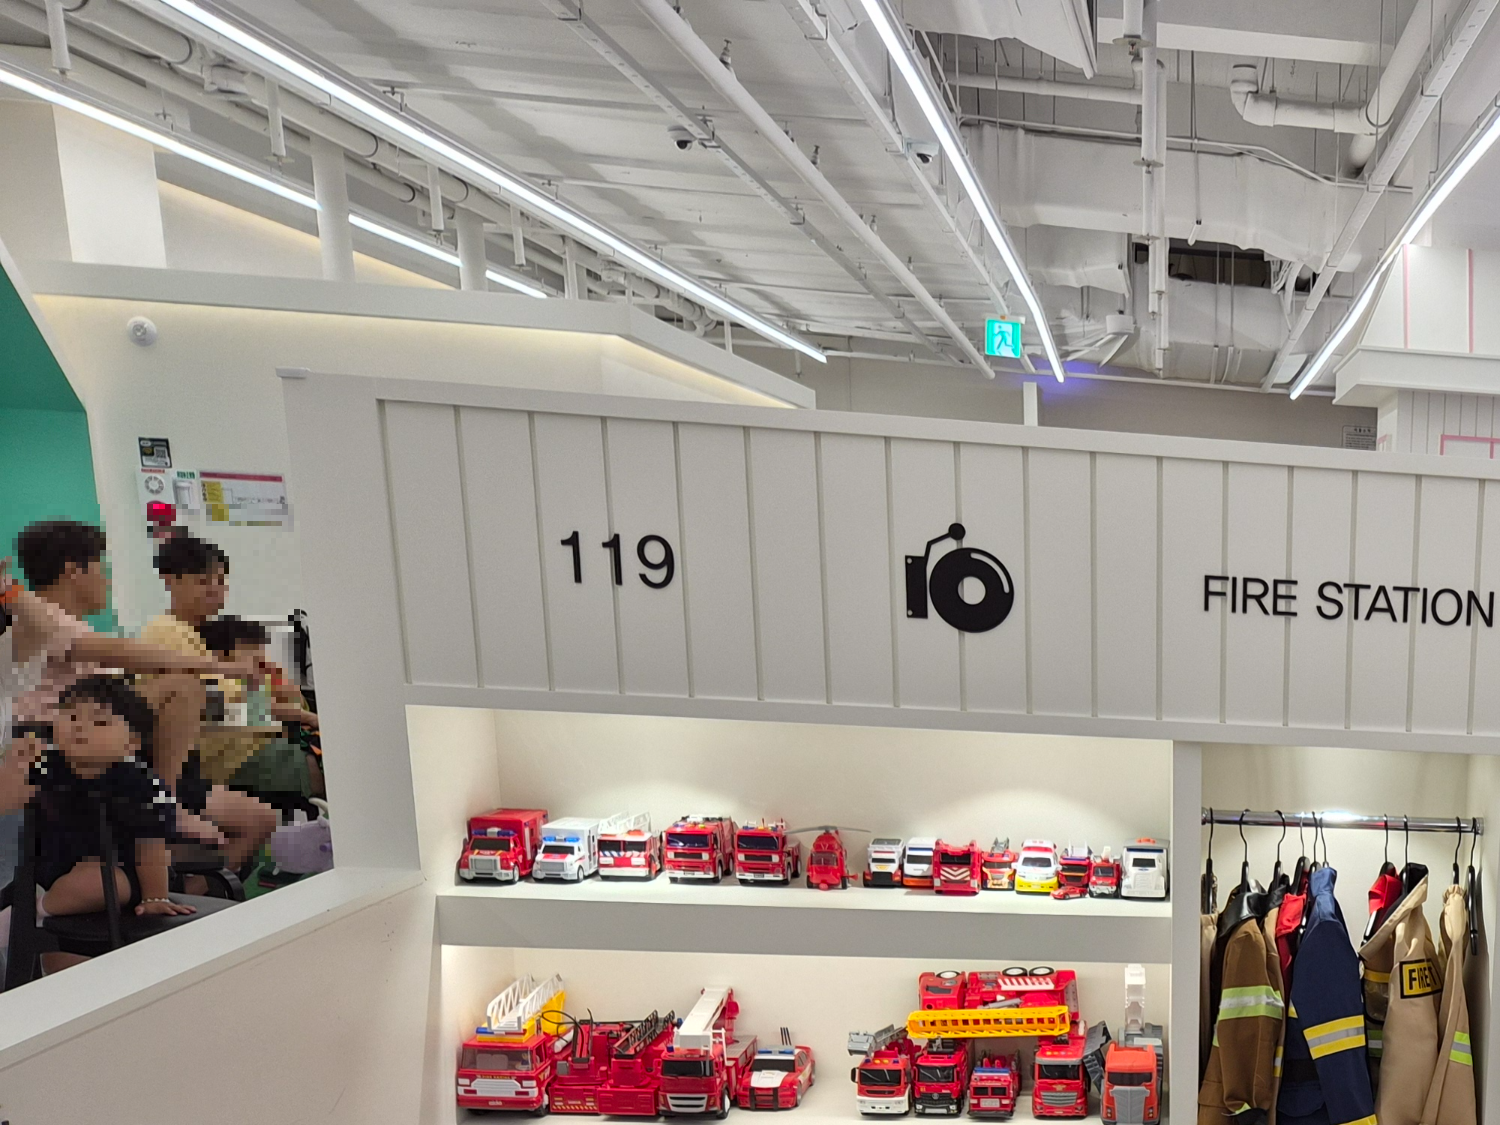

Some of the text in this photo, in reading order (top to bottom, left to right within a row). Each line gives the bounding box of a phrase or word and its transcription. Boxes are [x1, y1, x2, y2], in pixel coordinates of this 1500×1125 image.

[560, 530, 675, 590] 119
[1204, 575, 1495, 628] FIRE STATION
